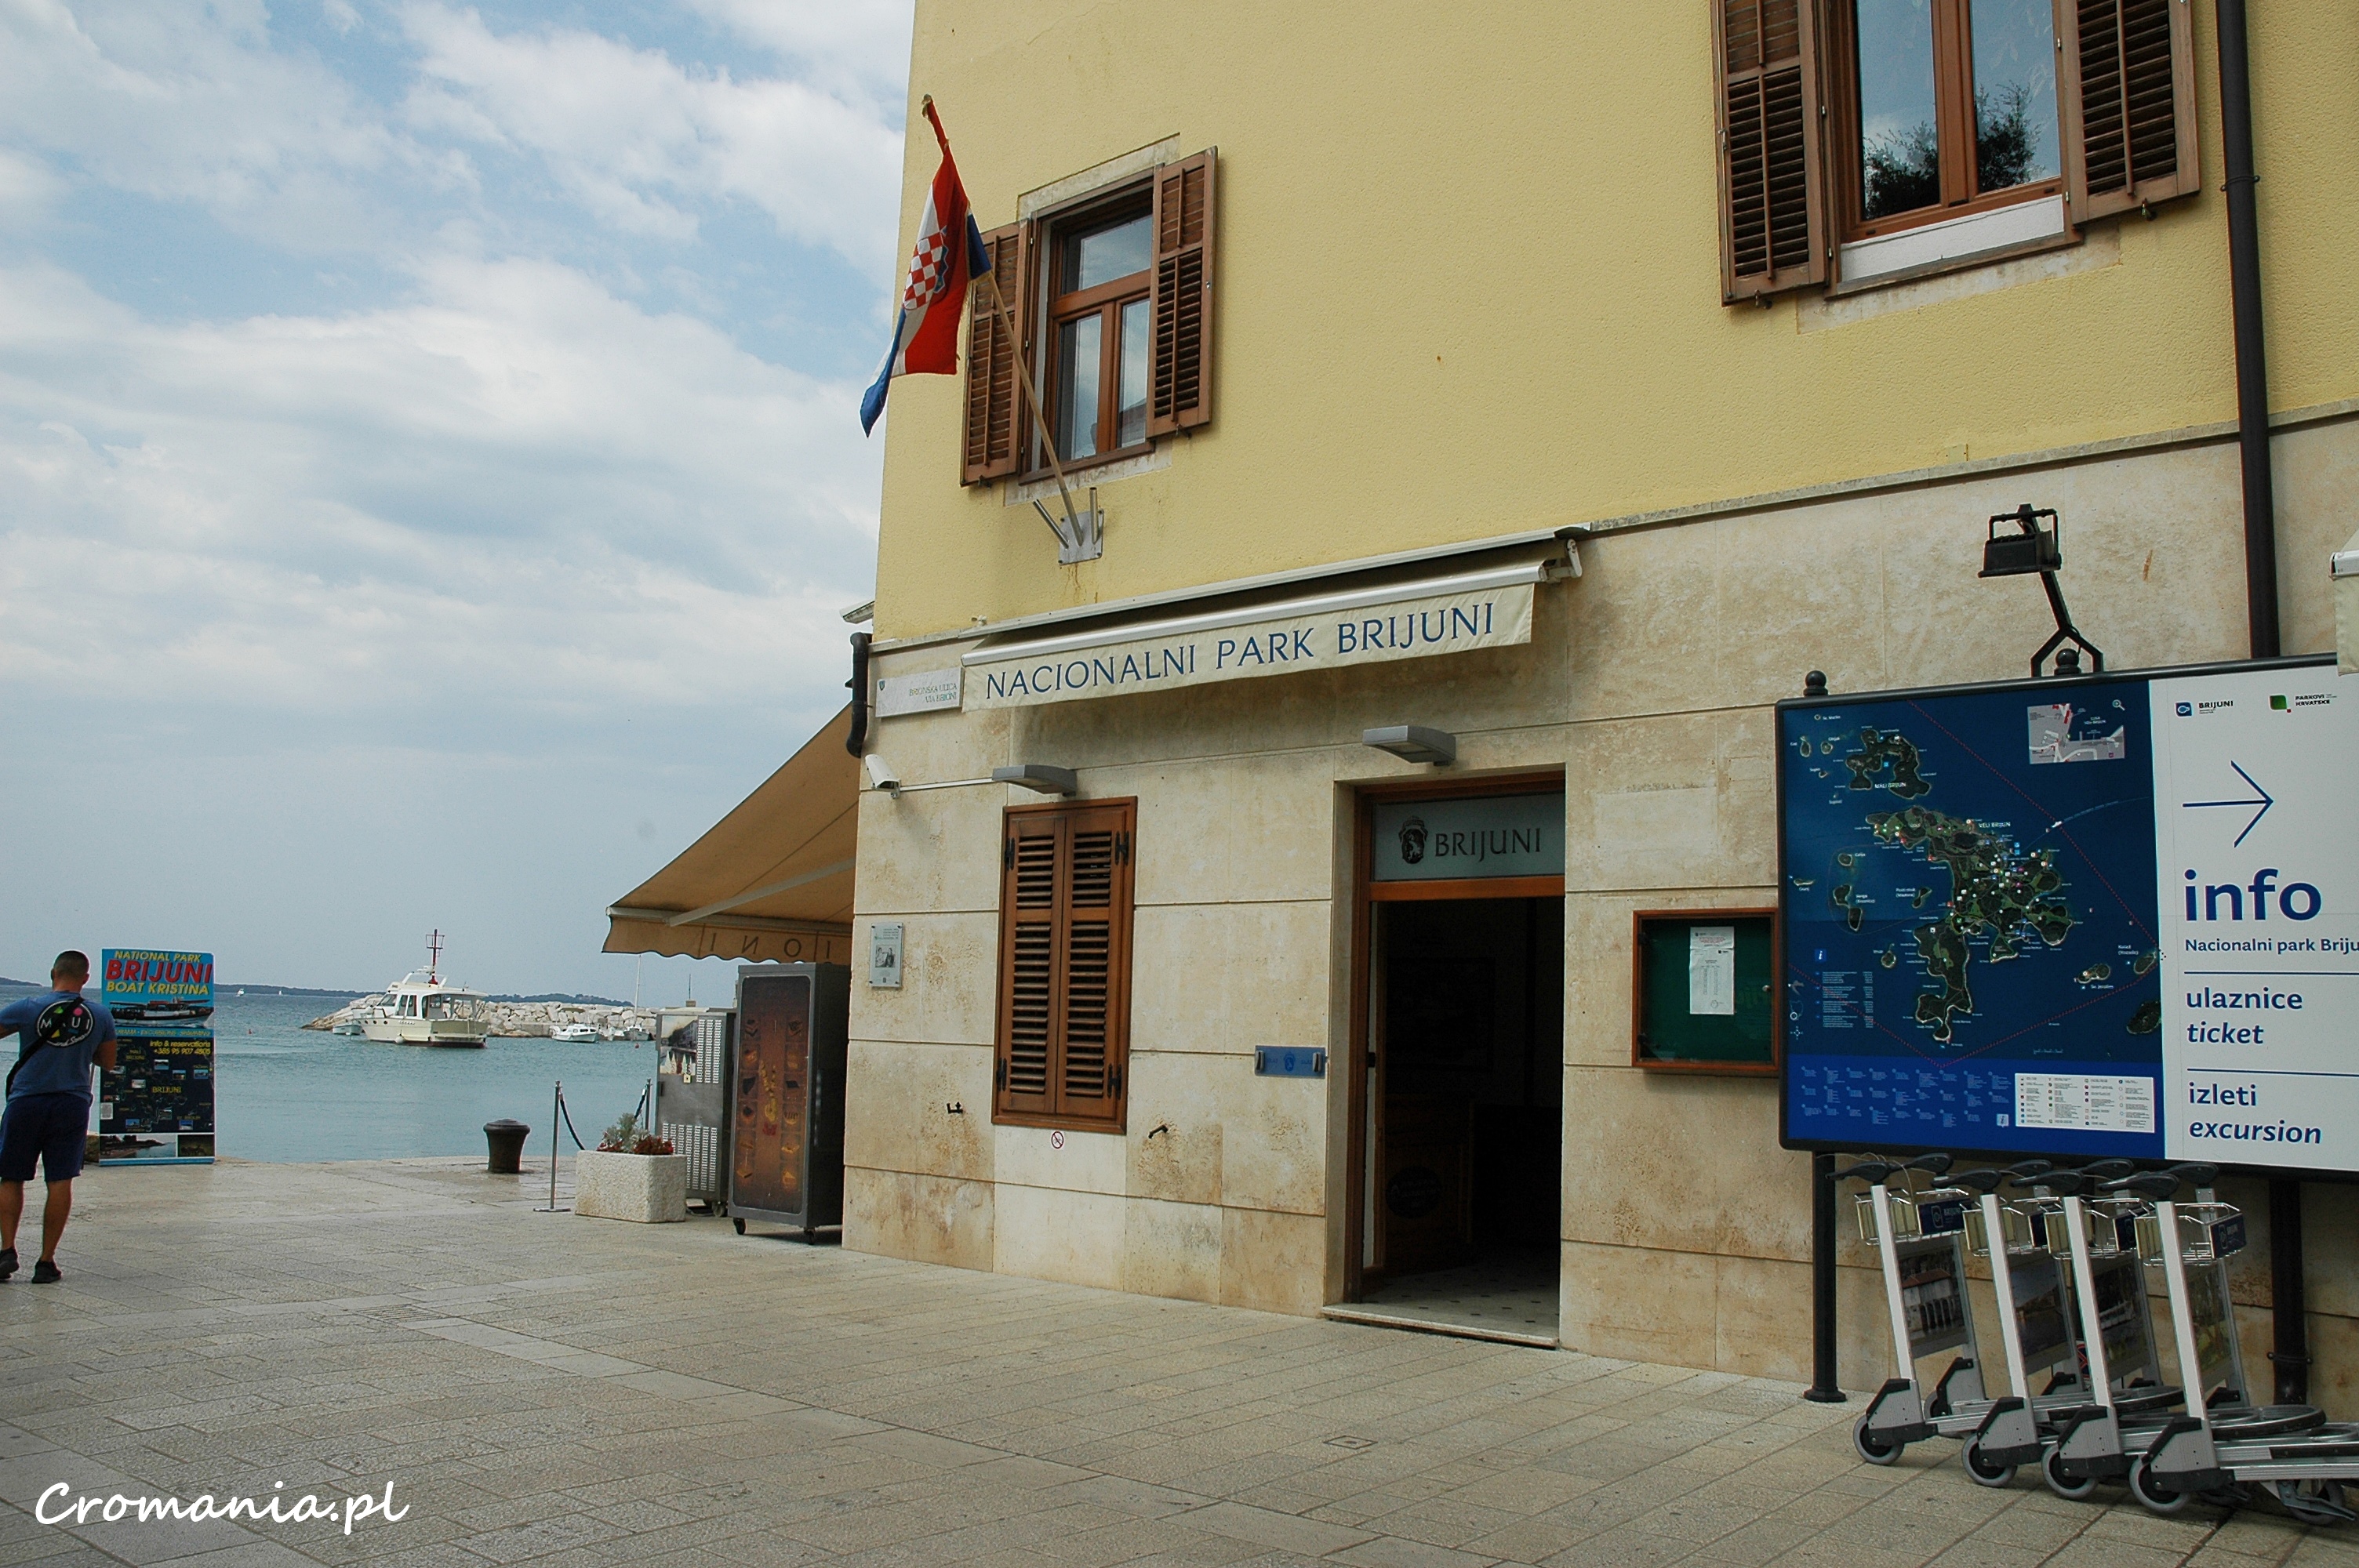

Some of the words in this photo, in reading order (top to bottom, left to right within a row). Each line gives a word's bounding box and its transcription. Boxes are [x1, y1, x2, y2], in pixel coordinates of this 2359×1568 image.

[986, 644, 1196, 700] NACIONALNI
[1216, 627, 1315, 670] PARK
[1337, 602, 1495, 655] BRIJUNI
[2198, 700, 2234, 709] BRIJUNI
[1434, 827, 1541, 862] BRIJUNI
[2184, 868, 2322, 921] info
[114, 950, 170, 961] NATIONAL
[173, 953, 202, 963] PARK
[2185, 938, 2272, 952] Nacionalni
[2277, 938, 2316, 955] park
[105, 959, 213, 984] BRIJUNI
[107, 981, 145, 993] BOAT
[147, 982, 209, 996] KRISTINA
[2186, 986, 2303, 1010] ulaznice
[40, 1016, 91, 1029] MUI
[2187, 1021, 2264, 1044] ticket
[2189, 1081, 2257, 1107] izleti
[2189, 1119, 2322, 1145] excursion
